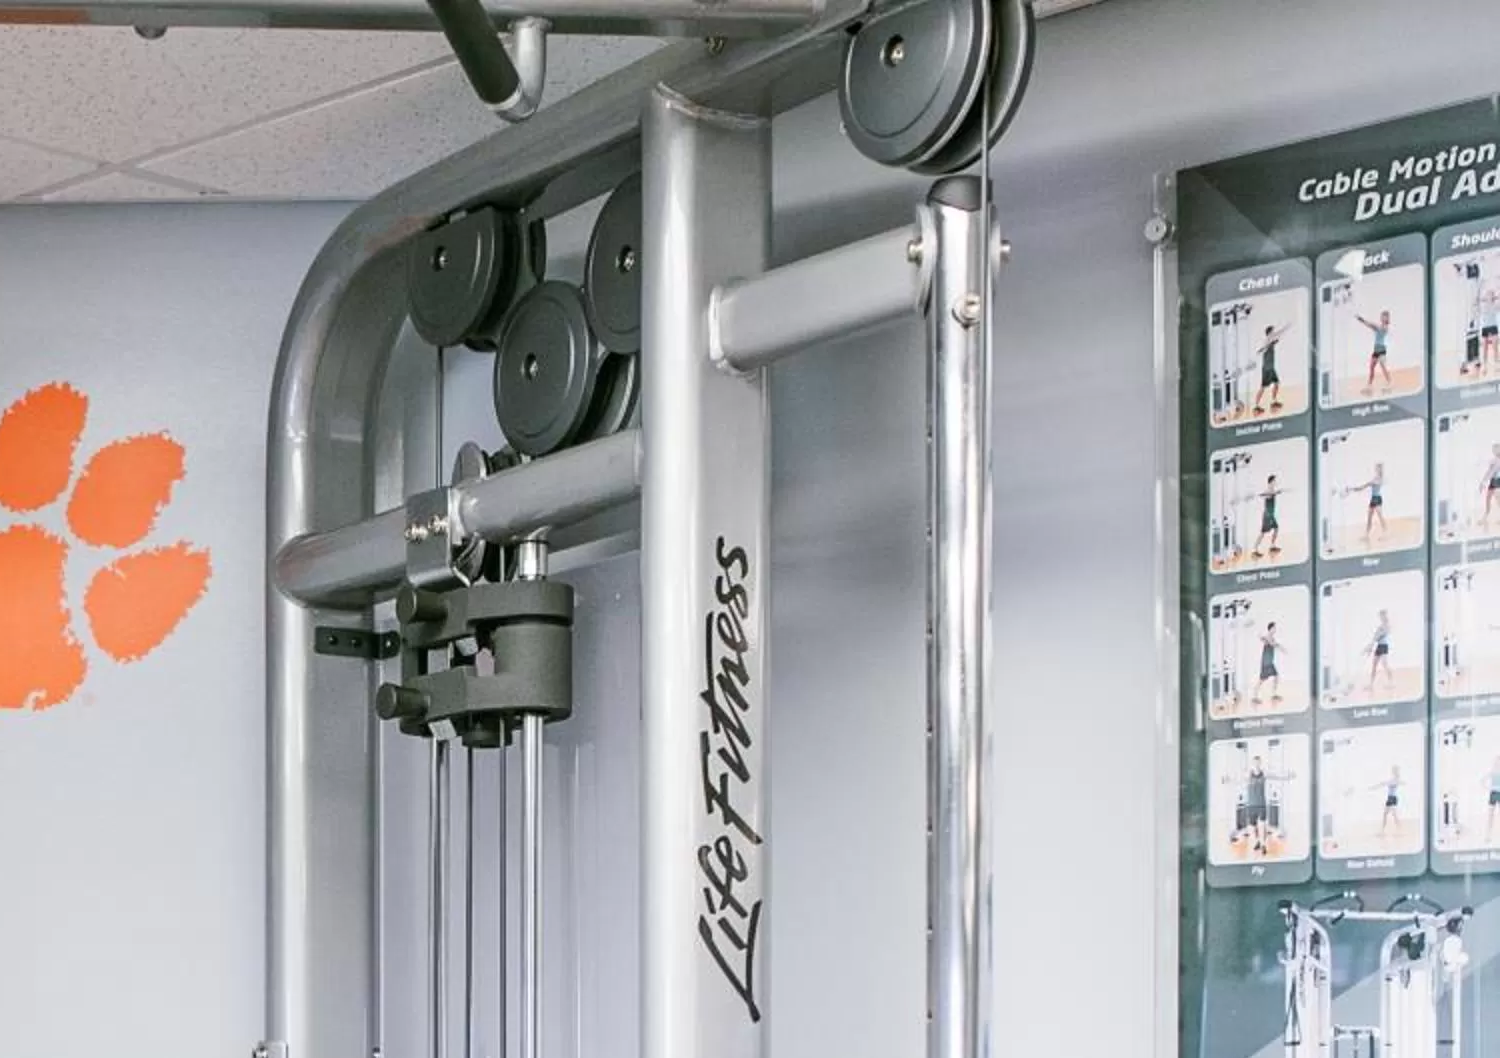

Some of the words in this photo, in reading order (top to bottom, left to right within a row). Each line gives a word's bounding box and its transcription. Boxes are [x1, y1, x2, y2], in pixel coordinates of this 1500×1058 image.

[1299, 168, 1378, 202] Cable
[1389, 142, 1497, 182] Motion
[1354, 176, 1442, 221] Dual
[1239, 273, 1280, 291] Chest
[1355, 249, 1390, 268] ack
[700, 536, 763, 844] Fitness
[699, 836, 762, 1023] Life
